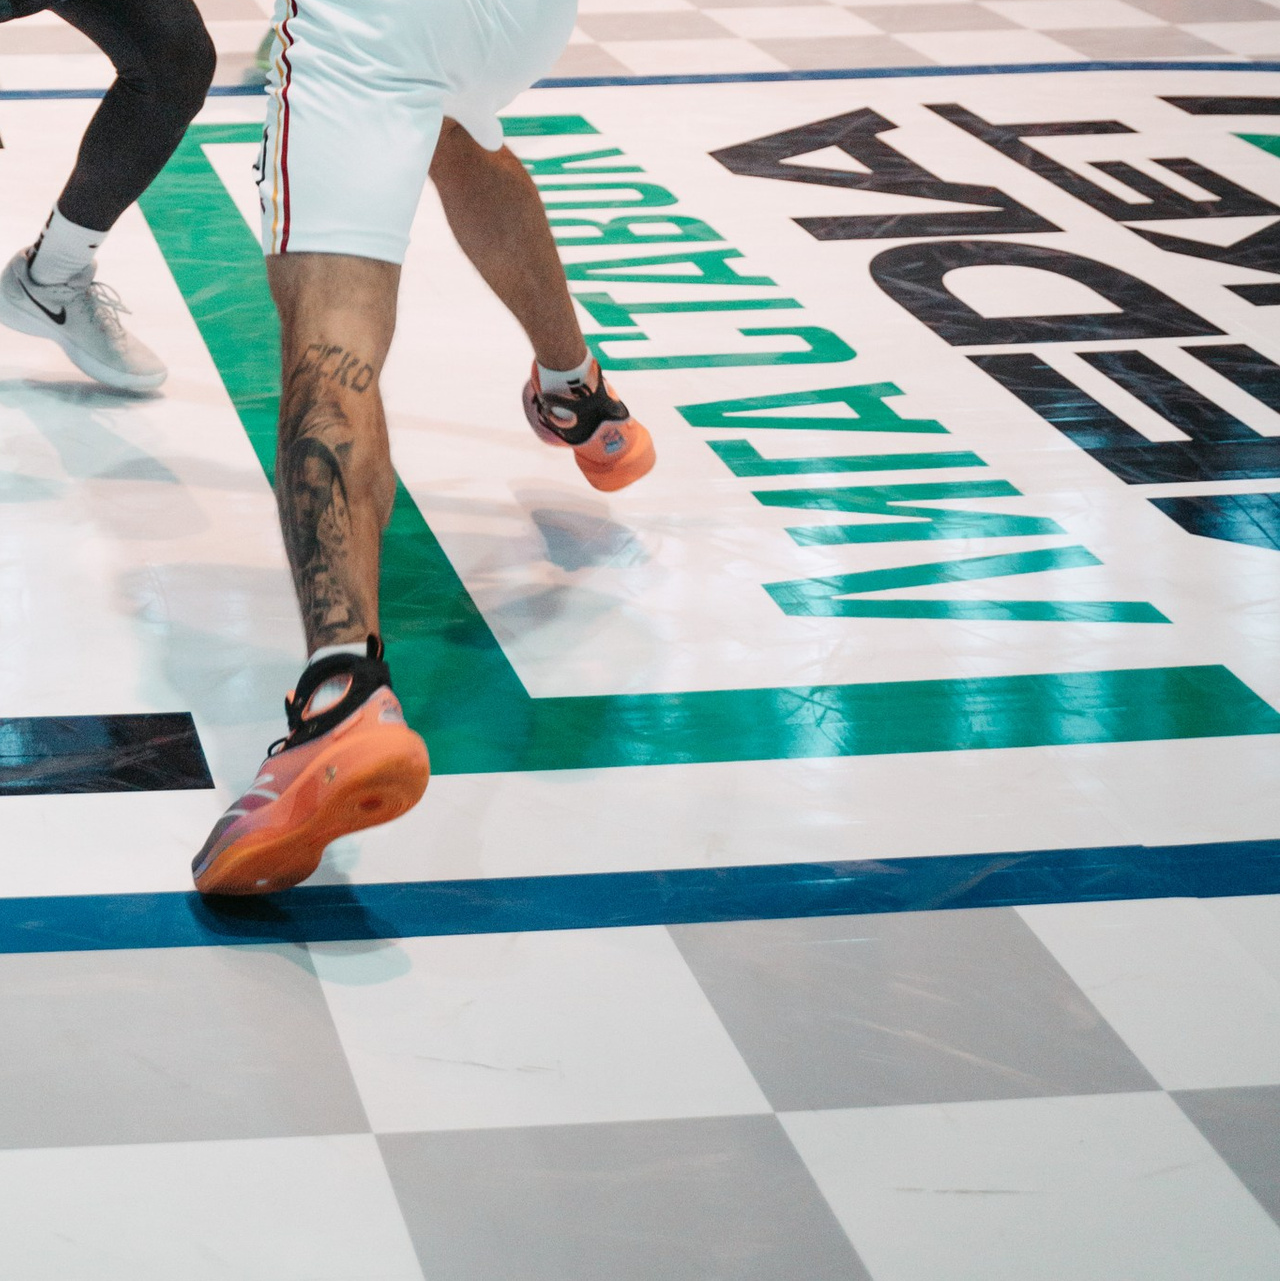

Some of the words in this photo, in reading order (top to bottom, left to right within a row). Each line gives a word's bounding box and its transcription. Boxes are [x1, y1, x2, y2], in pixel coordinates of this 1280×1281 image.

[519, 146, 858, 371] СТАВОК
[708, 106, 1280, 552] EDIA
[674, 381, 1174, 624] ЛИГА
